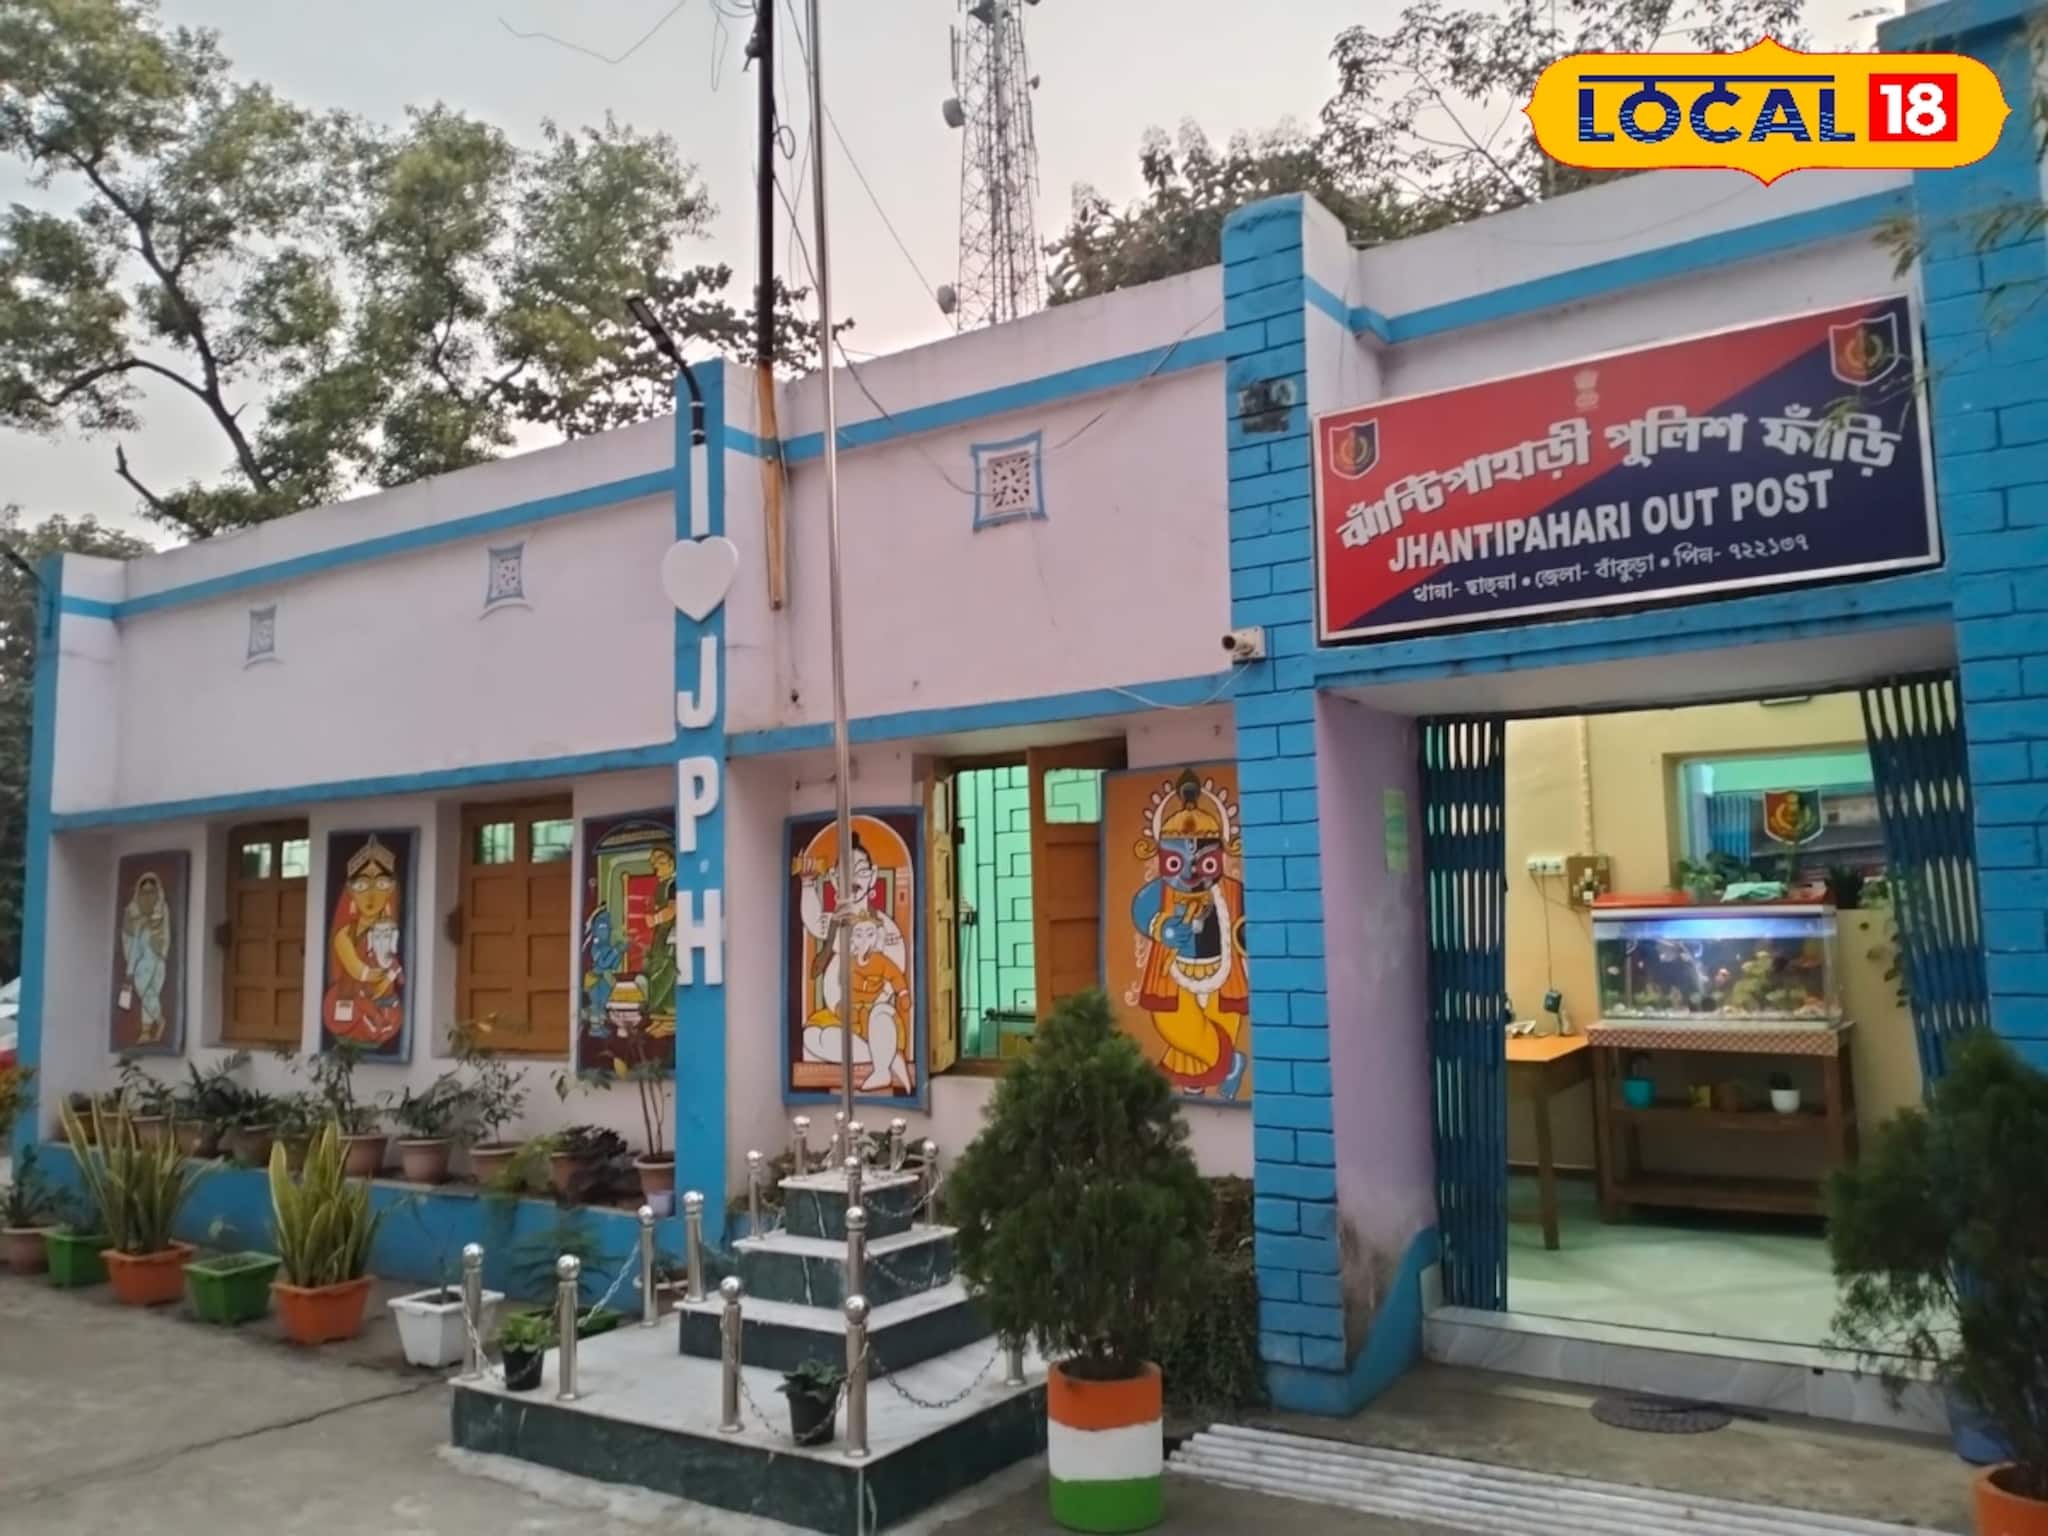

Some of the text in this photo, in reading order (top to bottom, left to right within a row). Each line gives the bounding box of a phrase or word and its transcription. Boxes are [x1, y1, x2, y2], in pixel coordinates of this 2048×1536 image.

[1603, 405, 1748, 468] পুলিশ
[1759, 403, 1903, 477] ফাঁড়ি
[1388, 470, 1834, 572] JHANTIPAHARI OUT POST
[1593, 552, 1656, 584] বাঁকুড়া
[1728, 533, 1810, 560] ৭২২১৩৭
